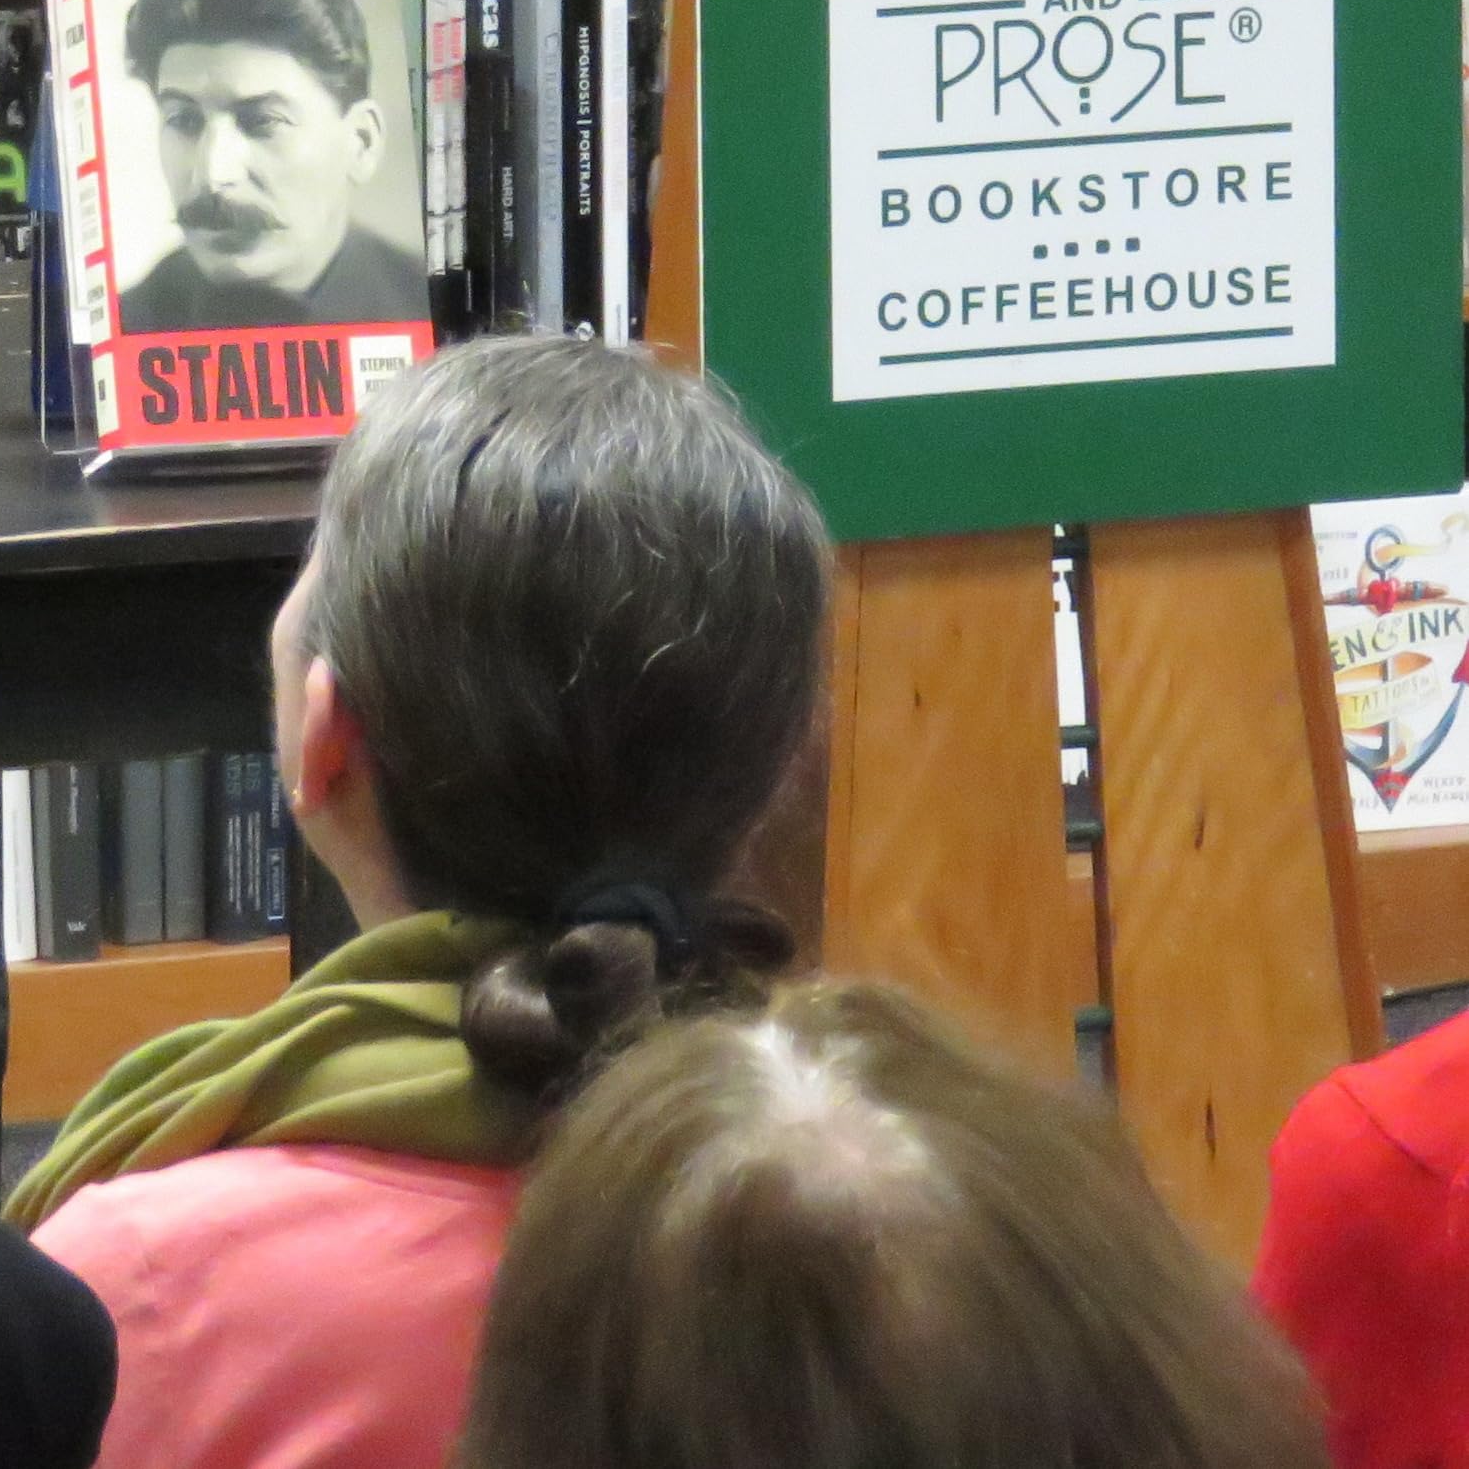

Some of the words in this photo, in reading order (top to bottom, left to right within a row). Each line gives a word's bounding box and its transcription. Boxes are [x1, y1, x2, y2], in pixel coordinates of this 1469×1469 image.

[578, 25, 591, 116] HIPGNOSIS
[934, 12, 1227, 127] PROSE
[501, 166, 514, 206] HARD
[578, 129, 592, 216] PORTRAITS
[881, 161, 1293, 228] BOOKSTORE
[501, 211, 514, 238] ART
[877, 264, 1292, 331] COFFEEHOUSE
[138, 338, 345, 425] STALIN
[359, 357, 406, 372] STEPHEN
[1407, 607, 1464, 644] INK
